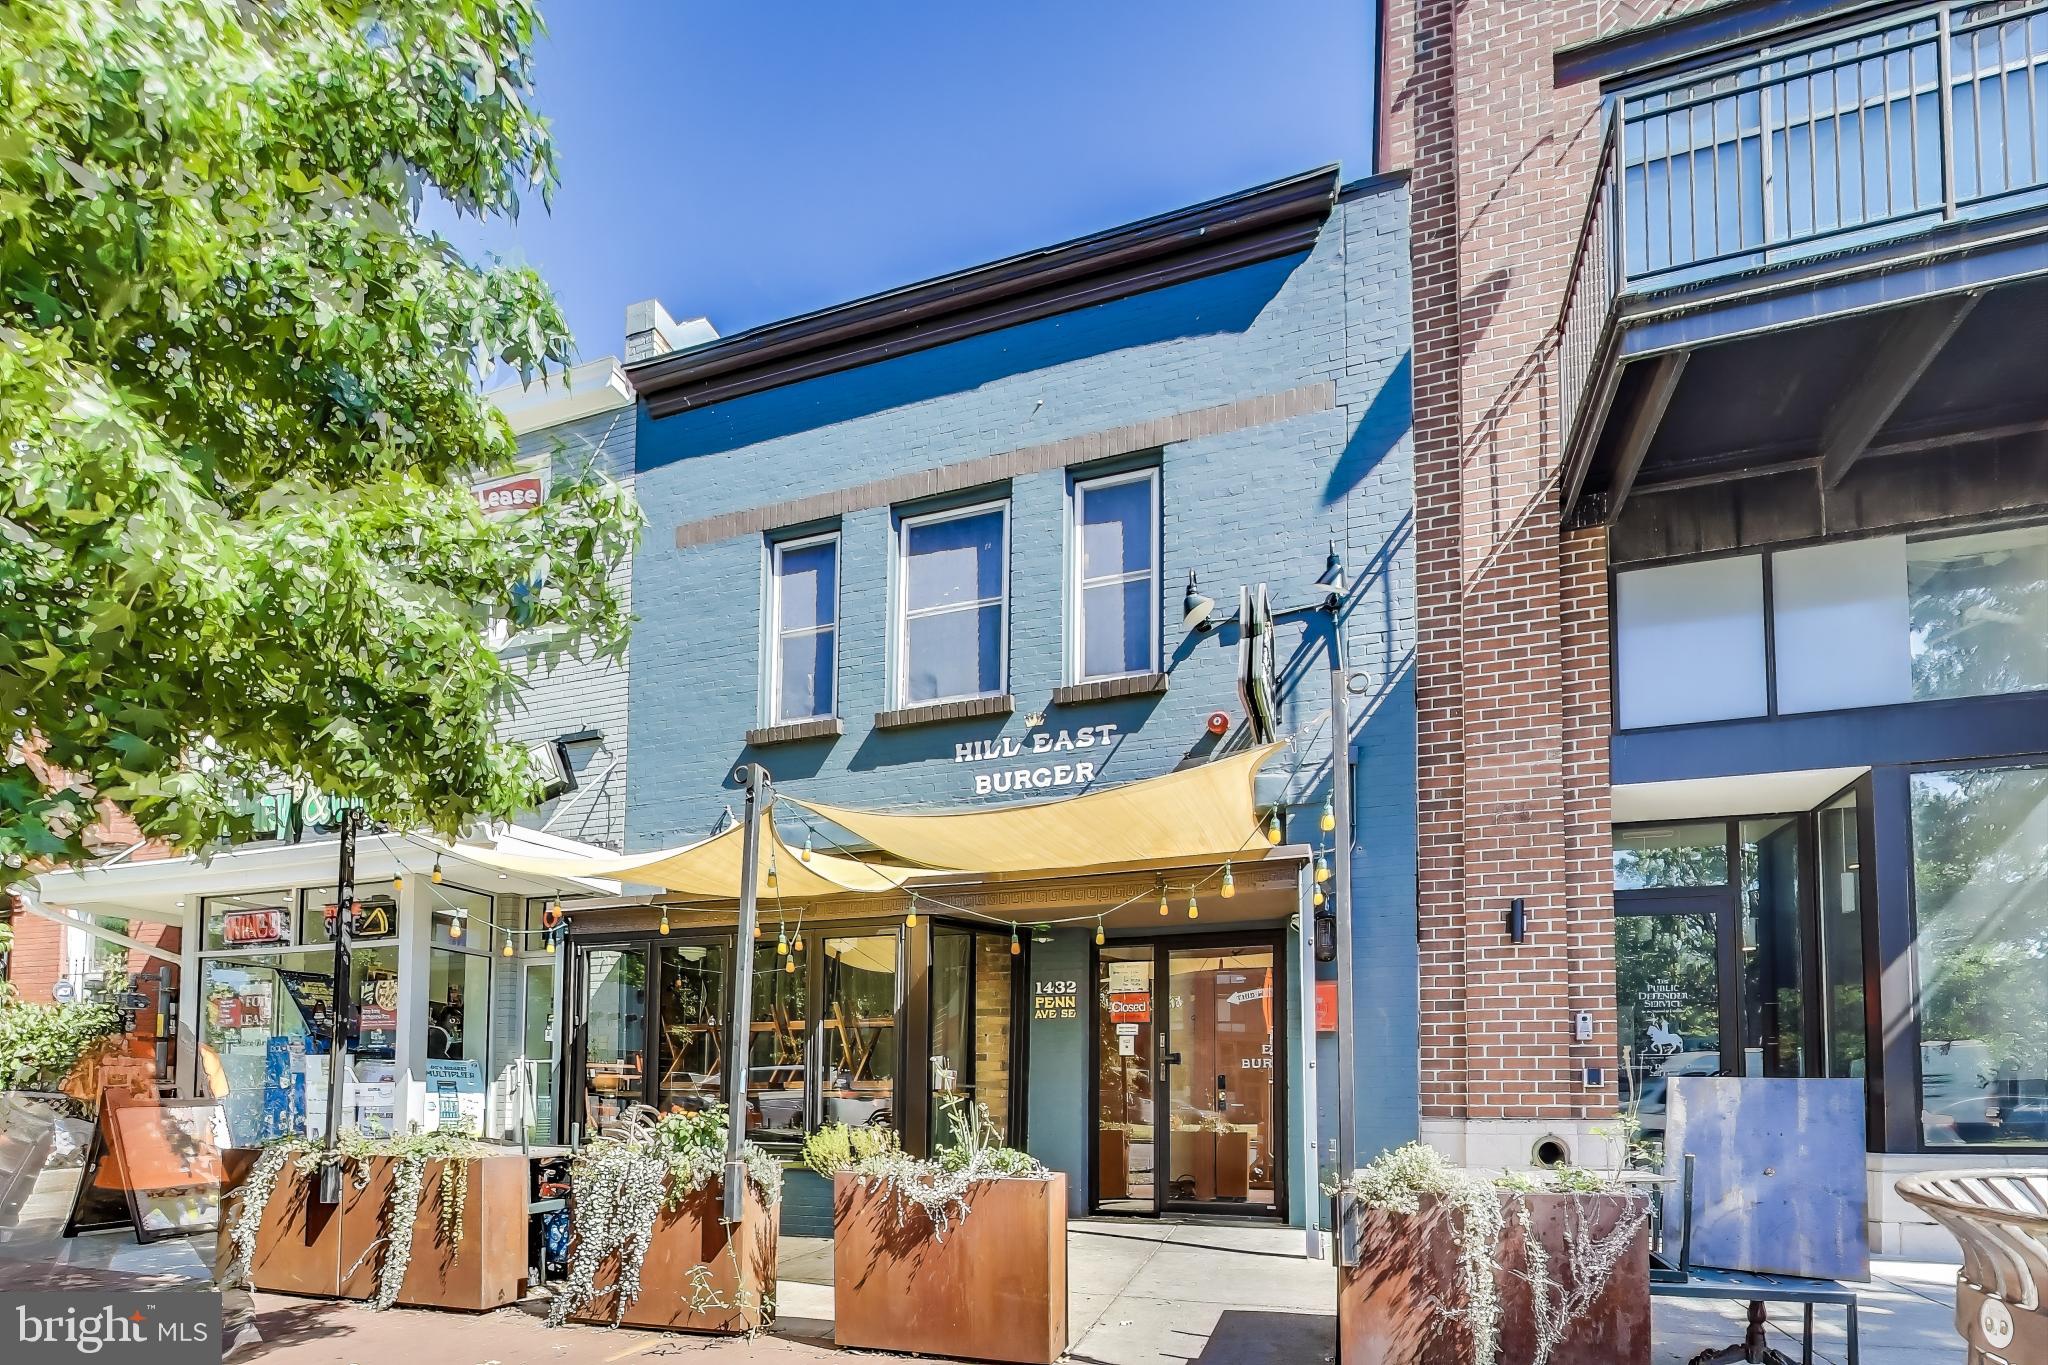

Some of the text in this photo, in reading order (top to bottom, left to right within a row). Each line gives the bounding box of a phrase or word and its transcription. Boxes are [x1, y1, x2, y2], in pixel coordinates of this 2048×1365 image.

[479, 489, 538, 509] Lease
[955, 724, 1117, 762] HILL EAST
[974, 762, 1095, 795] BURGER
[1035, 981, 1077, 994] 1432
[1647, 984, 1680, 992] PUBLIC
[1638, 992, 1689, 1000] DEFENDER
[1035, 996, 1076, 1008] PENN
[1111, 1001, 1146, 1012] Closed
[1035, 1009, 1076, 1019] AVE SE
[426, 1070, 475, 1079] MULTIPLIER
